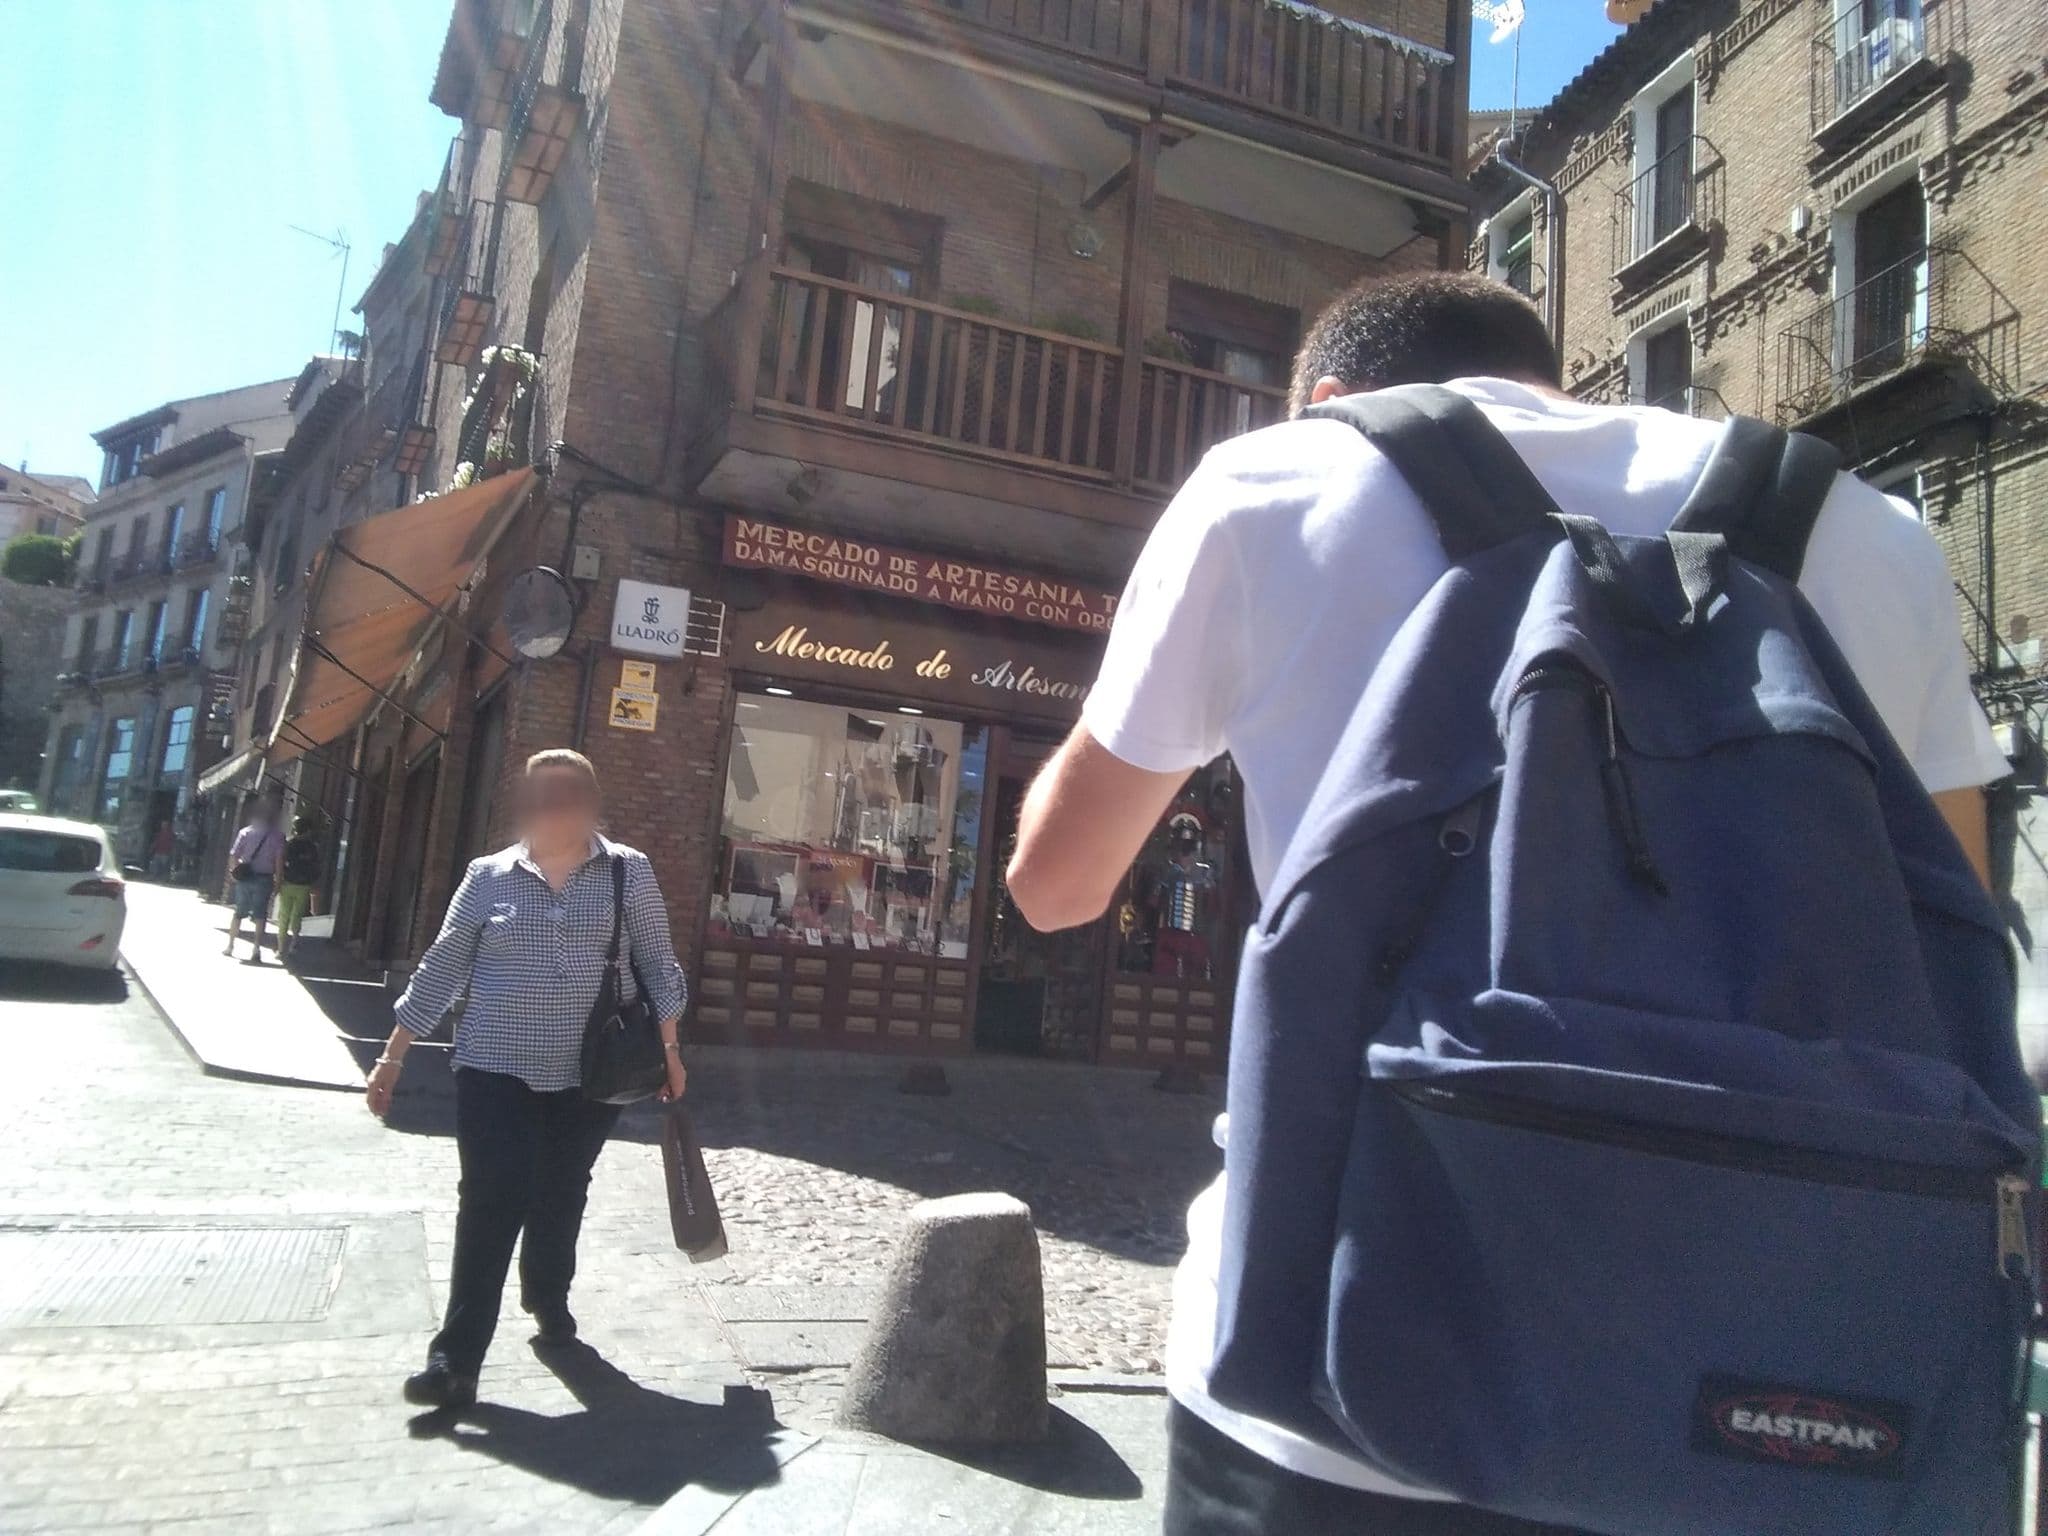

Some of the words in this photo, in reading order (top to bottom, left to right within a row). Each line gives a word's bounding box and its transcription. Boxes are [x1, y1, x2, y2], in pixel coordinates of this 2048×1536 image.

[735, 541, 918, 593] DAMASQUINADO
[928, 584, 941, 600] A
[950, 588, 1015, 613] MANO
[1026, 601, 1069, 622] CON
[737, 519, 880, 566] MERCADO
[889, 556, 918, 575] DE
[926, 561, 1086, 608] ARTESANIA
[1102, 594, 1118, 613] T
[617, 623, 680, 646] LLADRÓ
[755, 625, 894, 671] Mercado
[916, 650, 951, 679] de
[970, 660, 1089, 700] Artesan
[1731, 1409, 1878, 1450] EASTPAK
